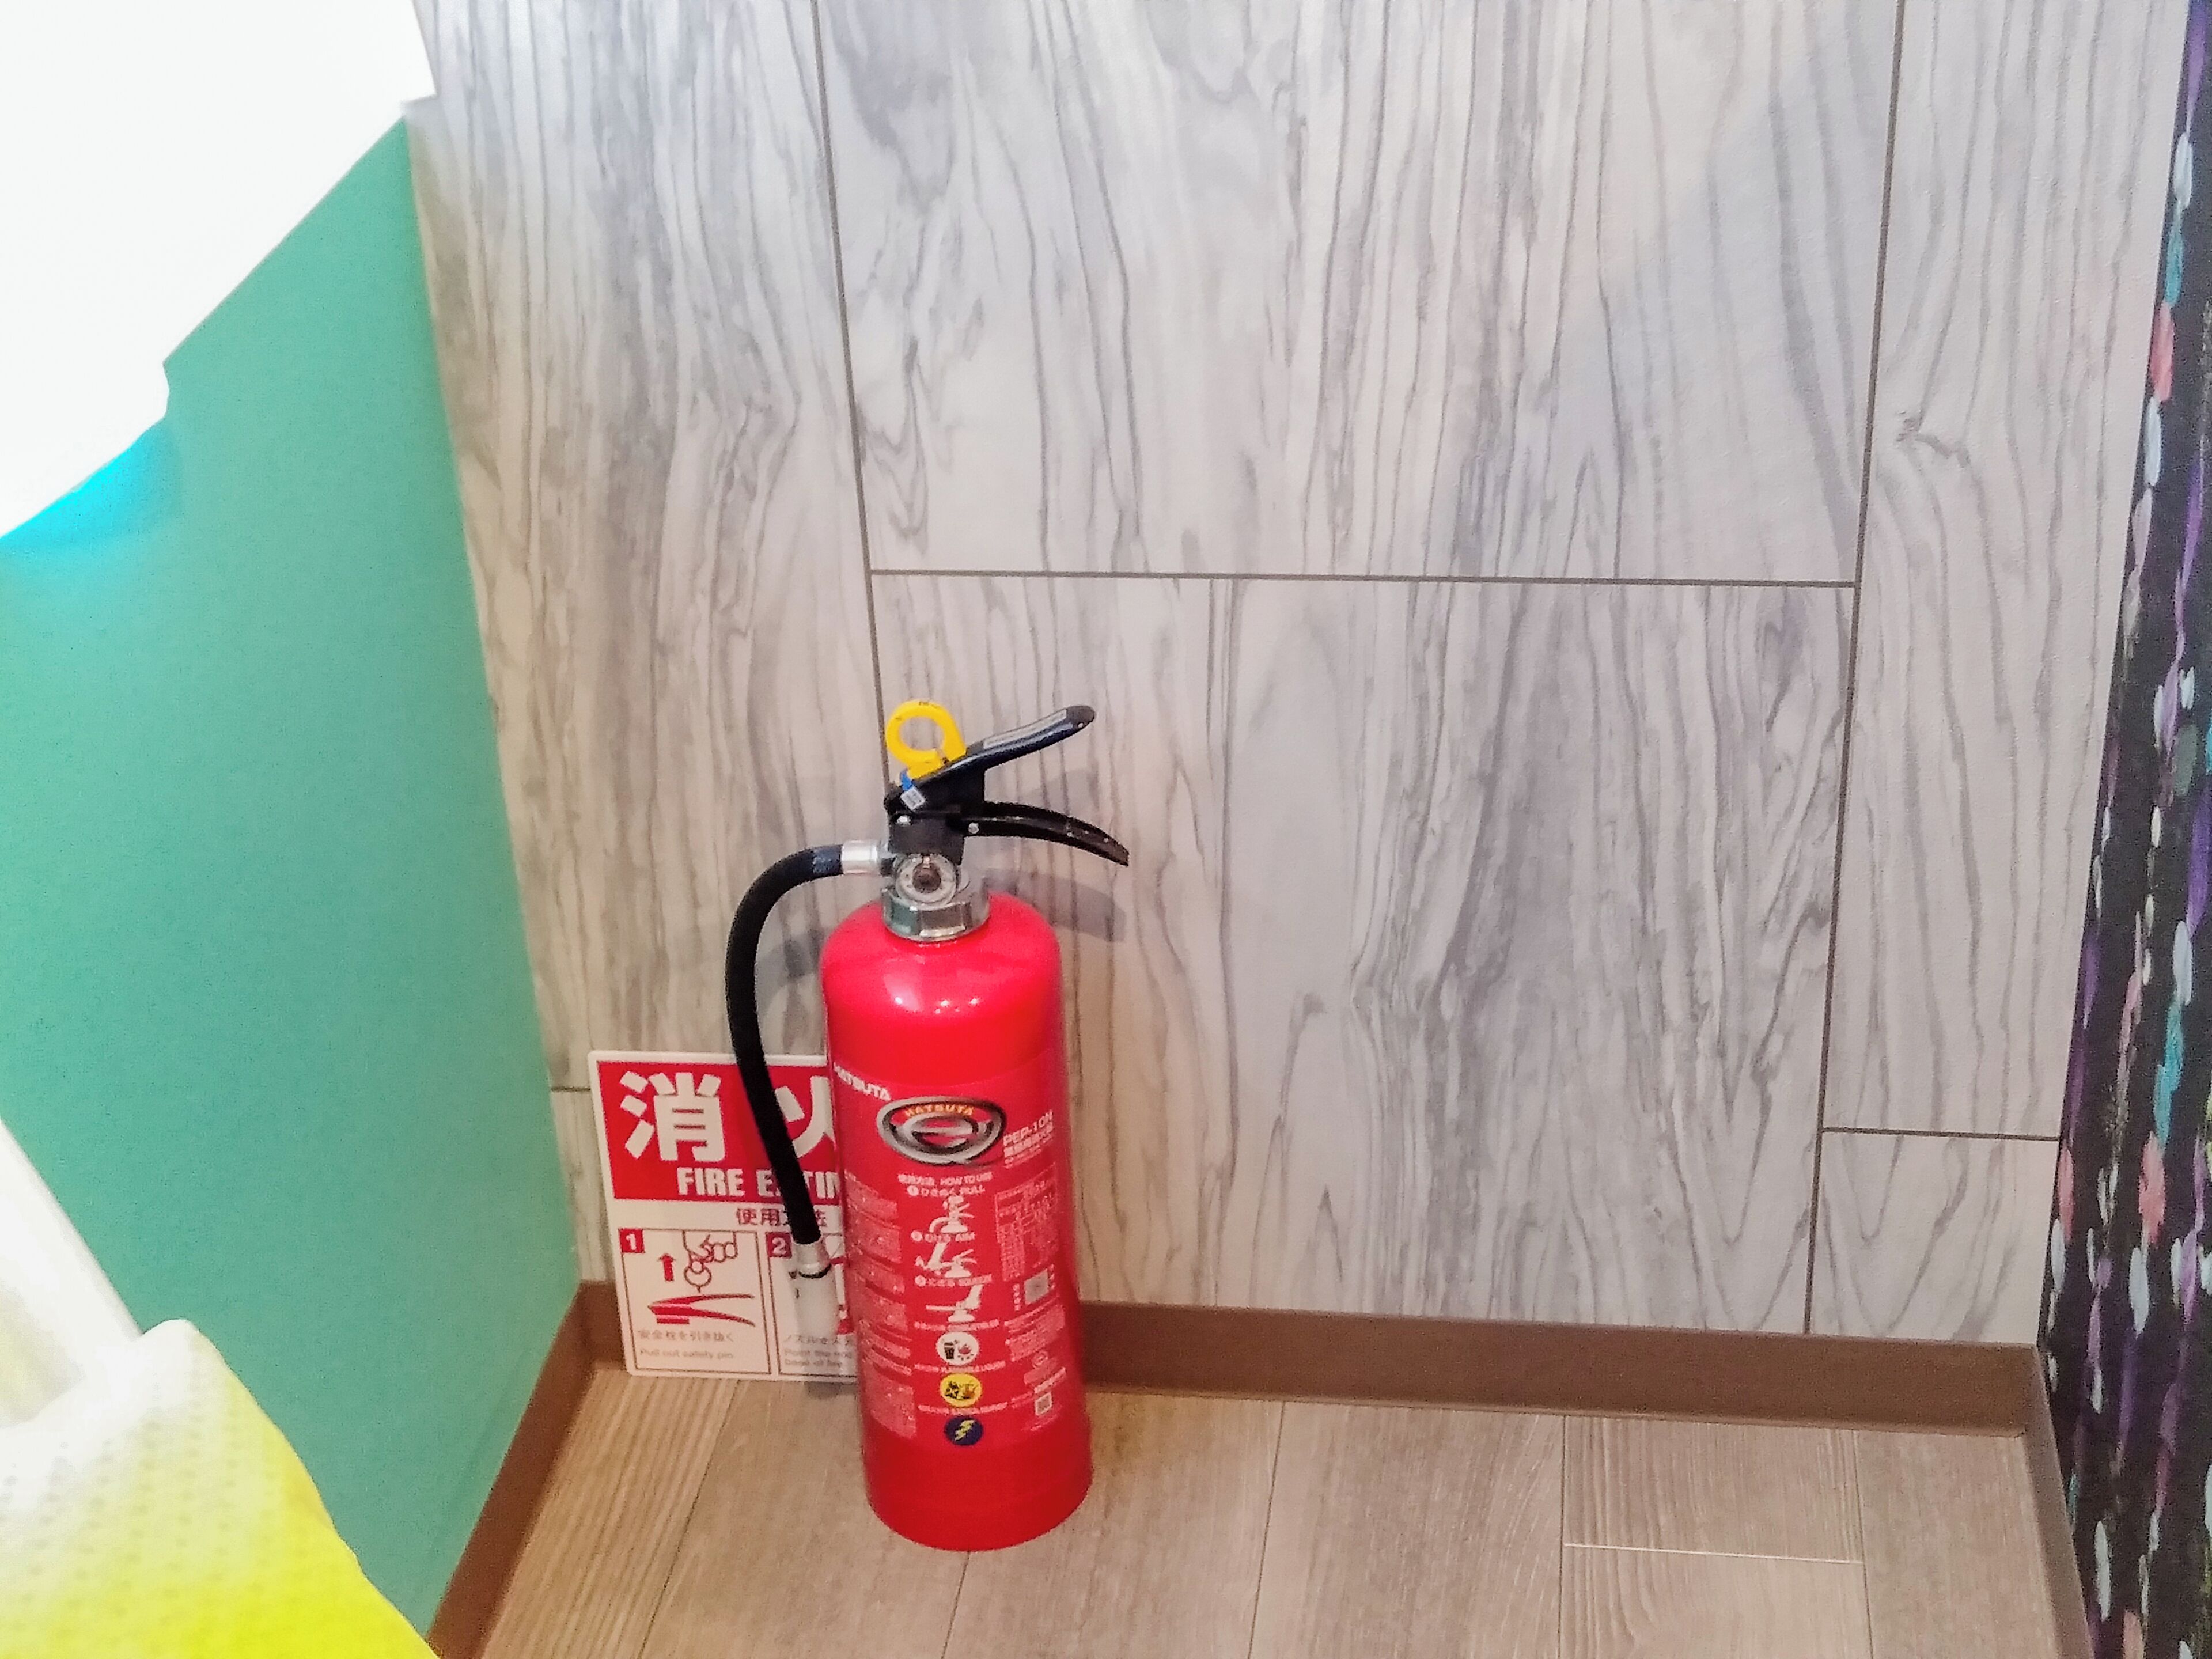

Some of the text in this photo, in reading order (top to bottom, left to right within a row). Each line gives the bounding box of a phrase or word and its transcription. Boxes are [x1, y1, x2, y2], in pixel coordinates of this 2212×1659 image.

[676, 1166, 745, 1196] FIRE
[756, 1169, 840, 1199] EIN
[627, 1233, 637, 1250] 1
[771, 1237, 787, 1255] 2
